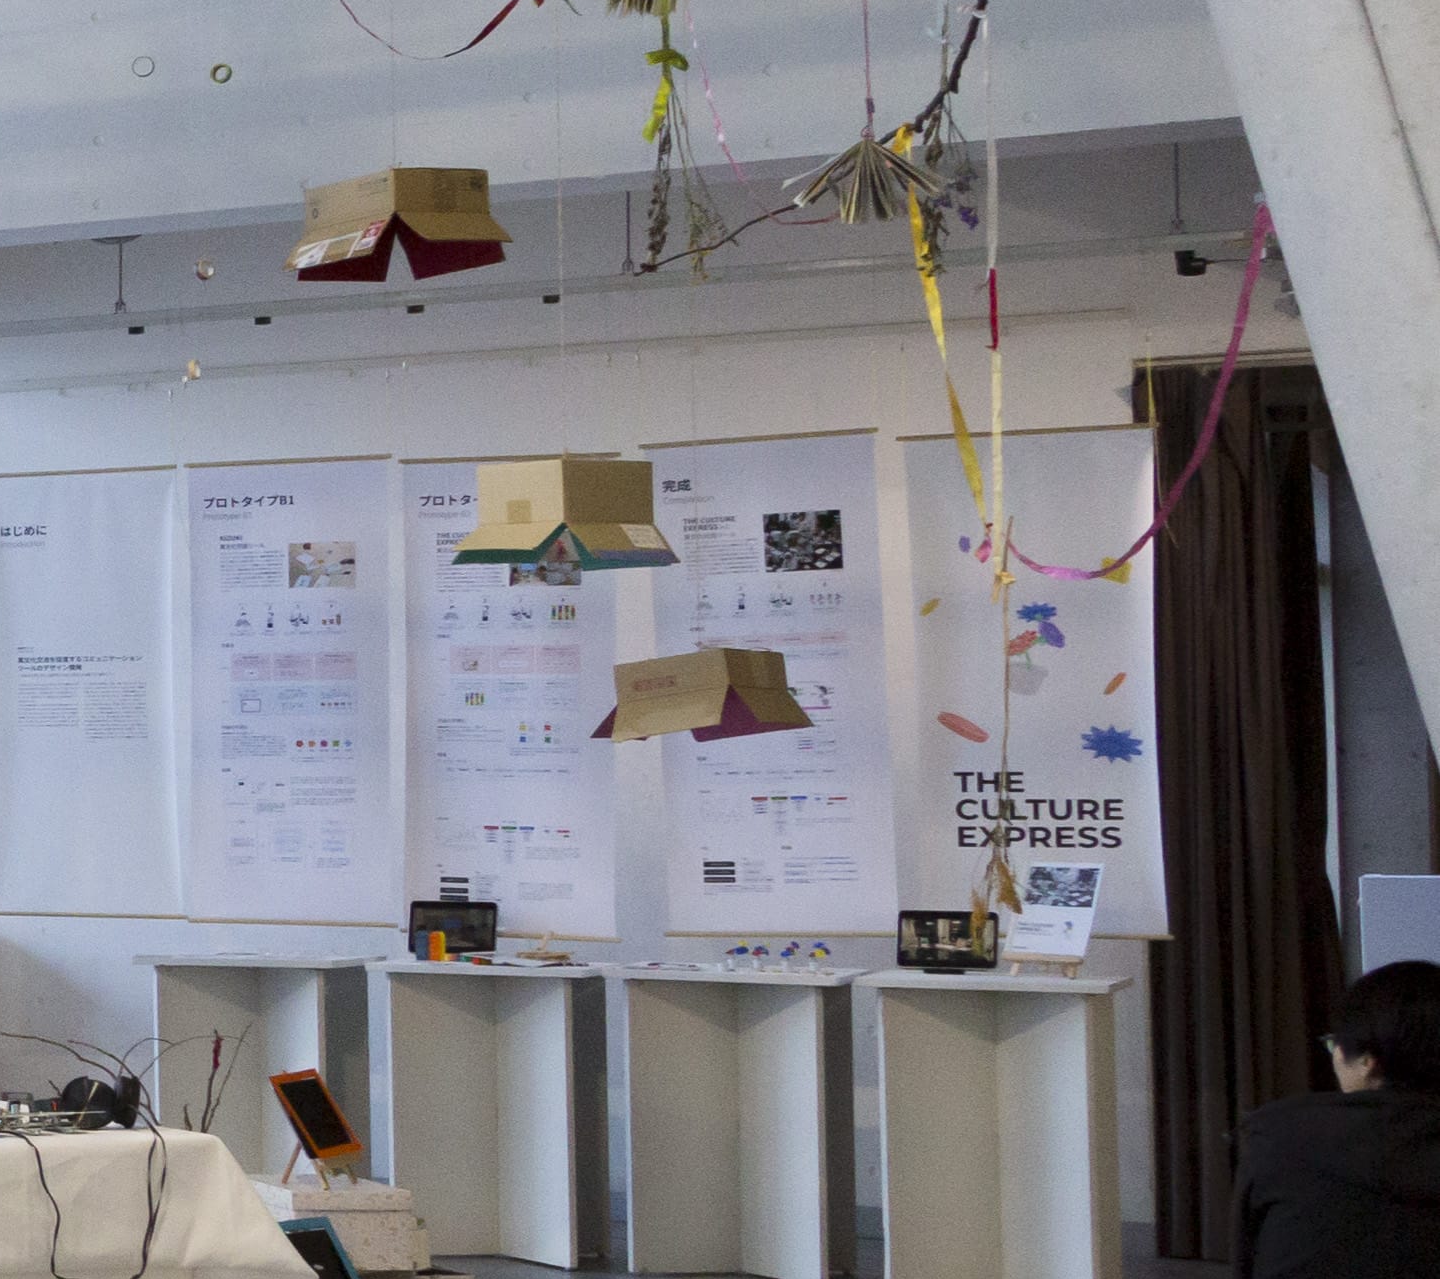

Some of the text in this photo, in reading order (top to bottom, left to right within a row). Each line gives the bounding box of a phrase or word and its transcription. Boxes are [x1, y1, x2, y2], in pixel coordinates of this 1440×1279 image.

[661, 479, 692, 493] 完成
[203, 495, 295, 509] プロトタイプB1
[419, 494, 478, 507] プロトタ
[0, 525, 48, 537] はじめに
[953, 771, 1025, 793] THE
[955, 799, 1125, 821] CULTURE
[957, 826, 1123, 849] EXPRESS
